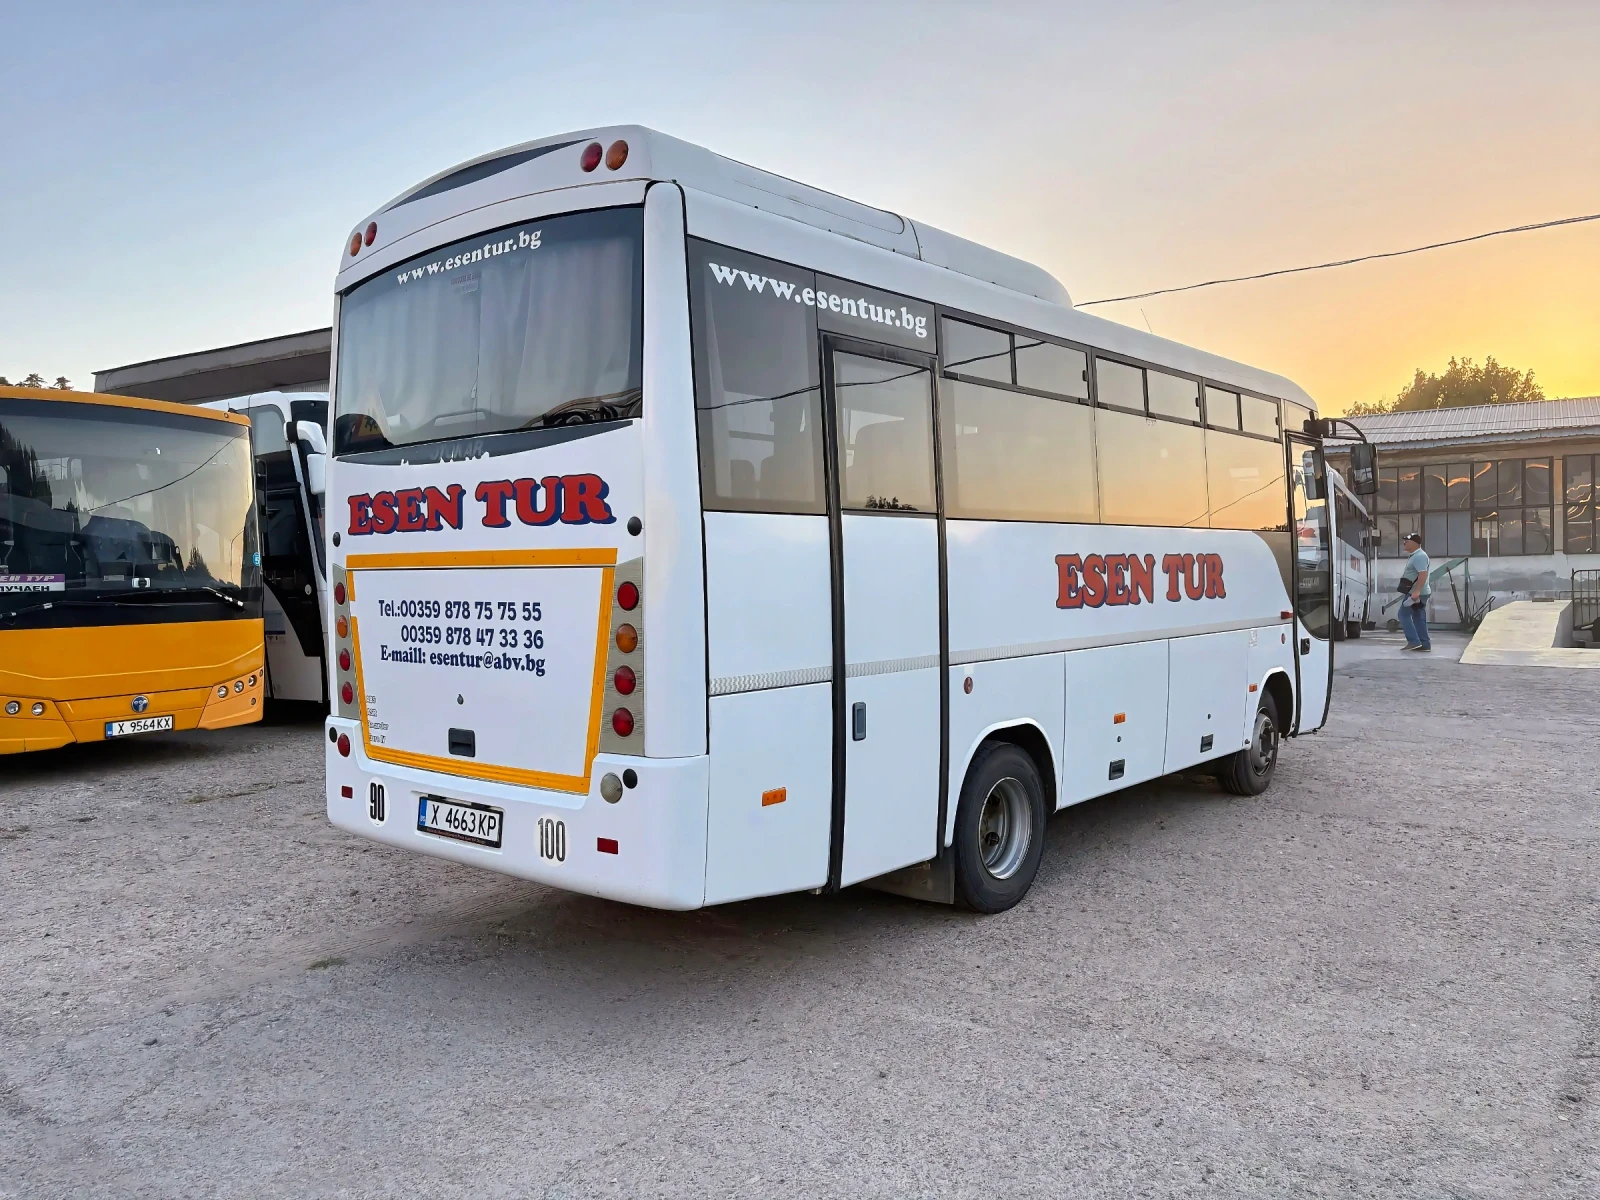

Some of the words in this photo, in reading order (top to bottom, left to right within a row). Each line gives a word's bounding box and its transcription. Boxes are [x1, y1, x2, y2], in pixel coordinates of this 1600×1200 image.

[396, 229, 542, 285] www.esentur.bg
[708, 262, 928, 338] www.esentur.bg
[347, 483, 466, 535] ESEN
[475, 473, 617, 528] TUR
[1055, 553, 1156, 609] ESEN
[1162, 553, 1226, 602] TUR
[445, 600, 471, 620] 878
[474, 601, 493, 620] 75
[497, 601, 517, 621] 75
[522, 602, 542, 622] 55
[401, 625, 442, 644] 00359
[445, 626, 472, 646] 878
[476, 627, 495, 647] 47
[499, 628, 518, 648] 33
[523, 629, 544, 650] 36
[380, 644, 427, 664] E-maill:
[429, 650, 546, 677] esentur@abv.bg
[369, 782, 385, 822] 90
[537, 817, 566, 862] 100
